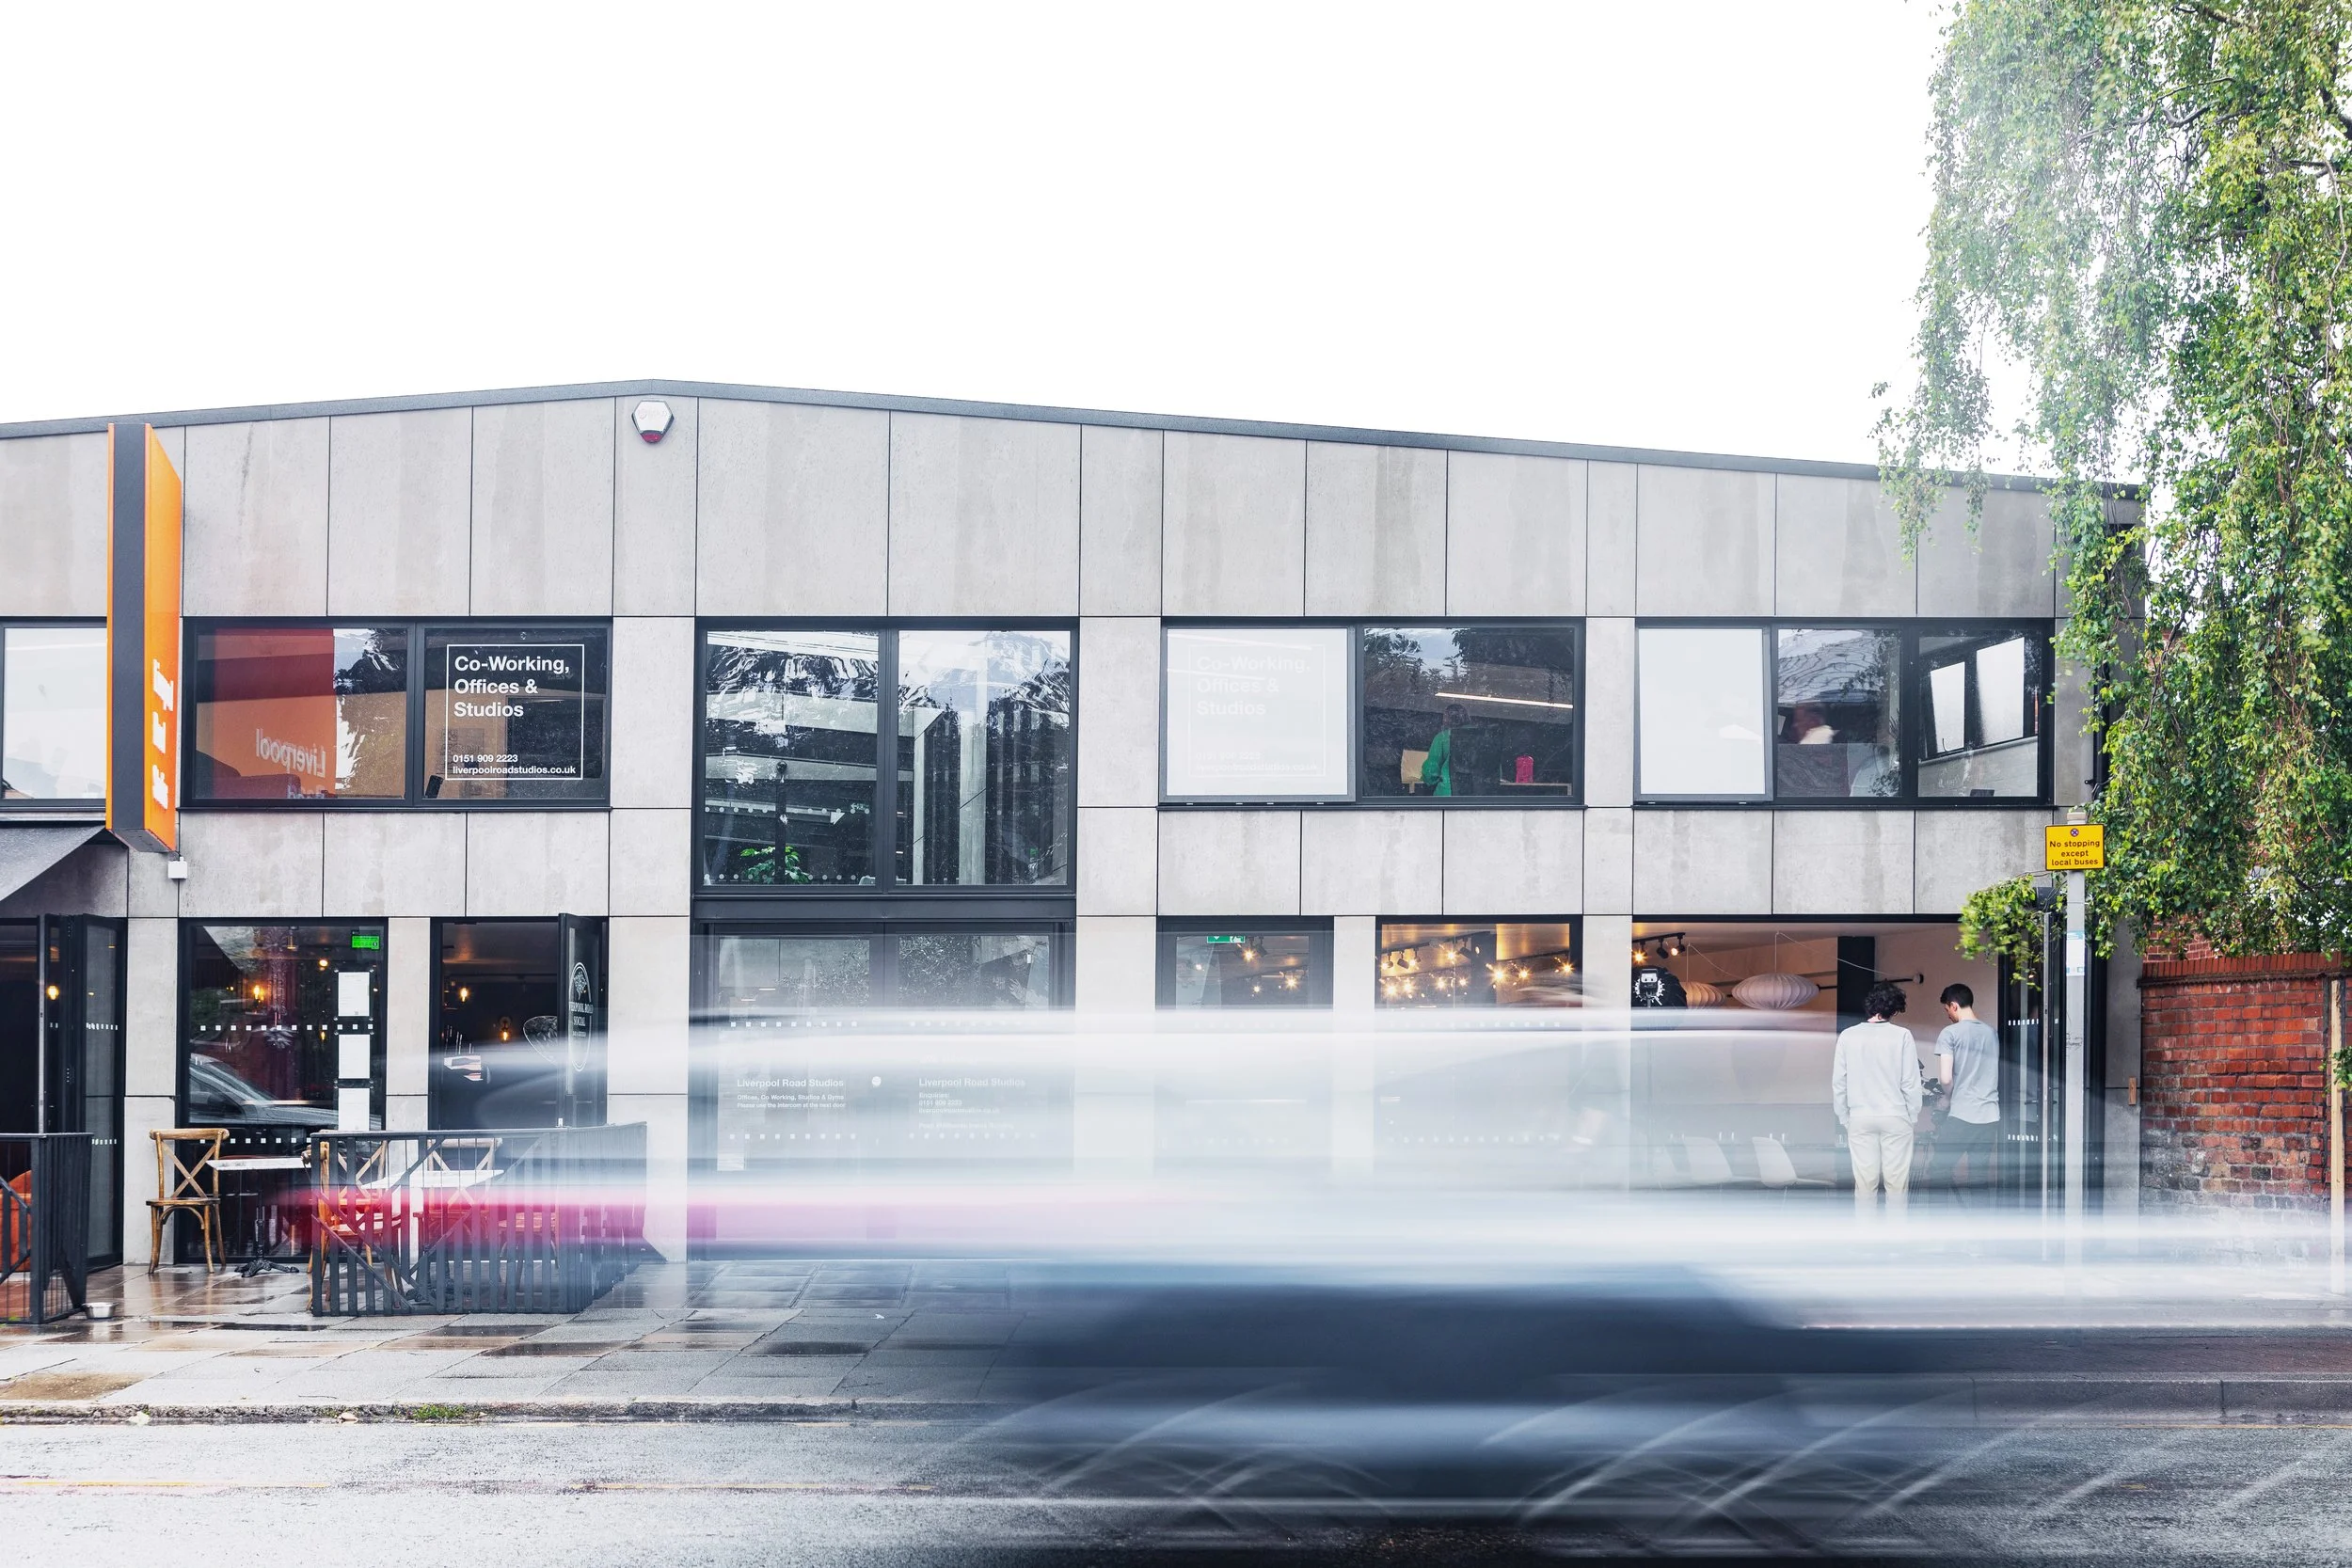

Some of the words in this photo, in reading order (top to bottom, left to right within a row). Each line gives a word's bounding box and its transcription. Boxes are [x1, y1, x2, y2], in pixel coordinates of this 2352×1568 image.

[454, 656, 569, 674] Co-Working,
[454, 678, 519, 694] Offices
[525, 678, 539, 694] &
[1197, 677, 1262, 693] Offices
[1266, 677, 1279, 693] &
[453, 702, 524, 718] Studios
[1196, 701, 1266, 716] Studios
[453, 754, 474, 763] 0151
[477, 754, 494, 763] 909
[496, 754, 518, 763] 2223
[453, 766, 576, 775] liverpoolroadstudios.co.uk
[737, 1079, 780, 1088] Liverpool
[782, 1079, 806, 1087] Road
[809, 1079, 844, 1087] Studios
[918, 1078, 961, 1087] Liverpool
